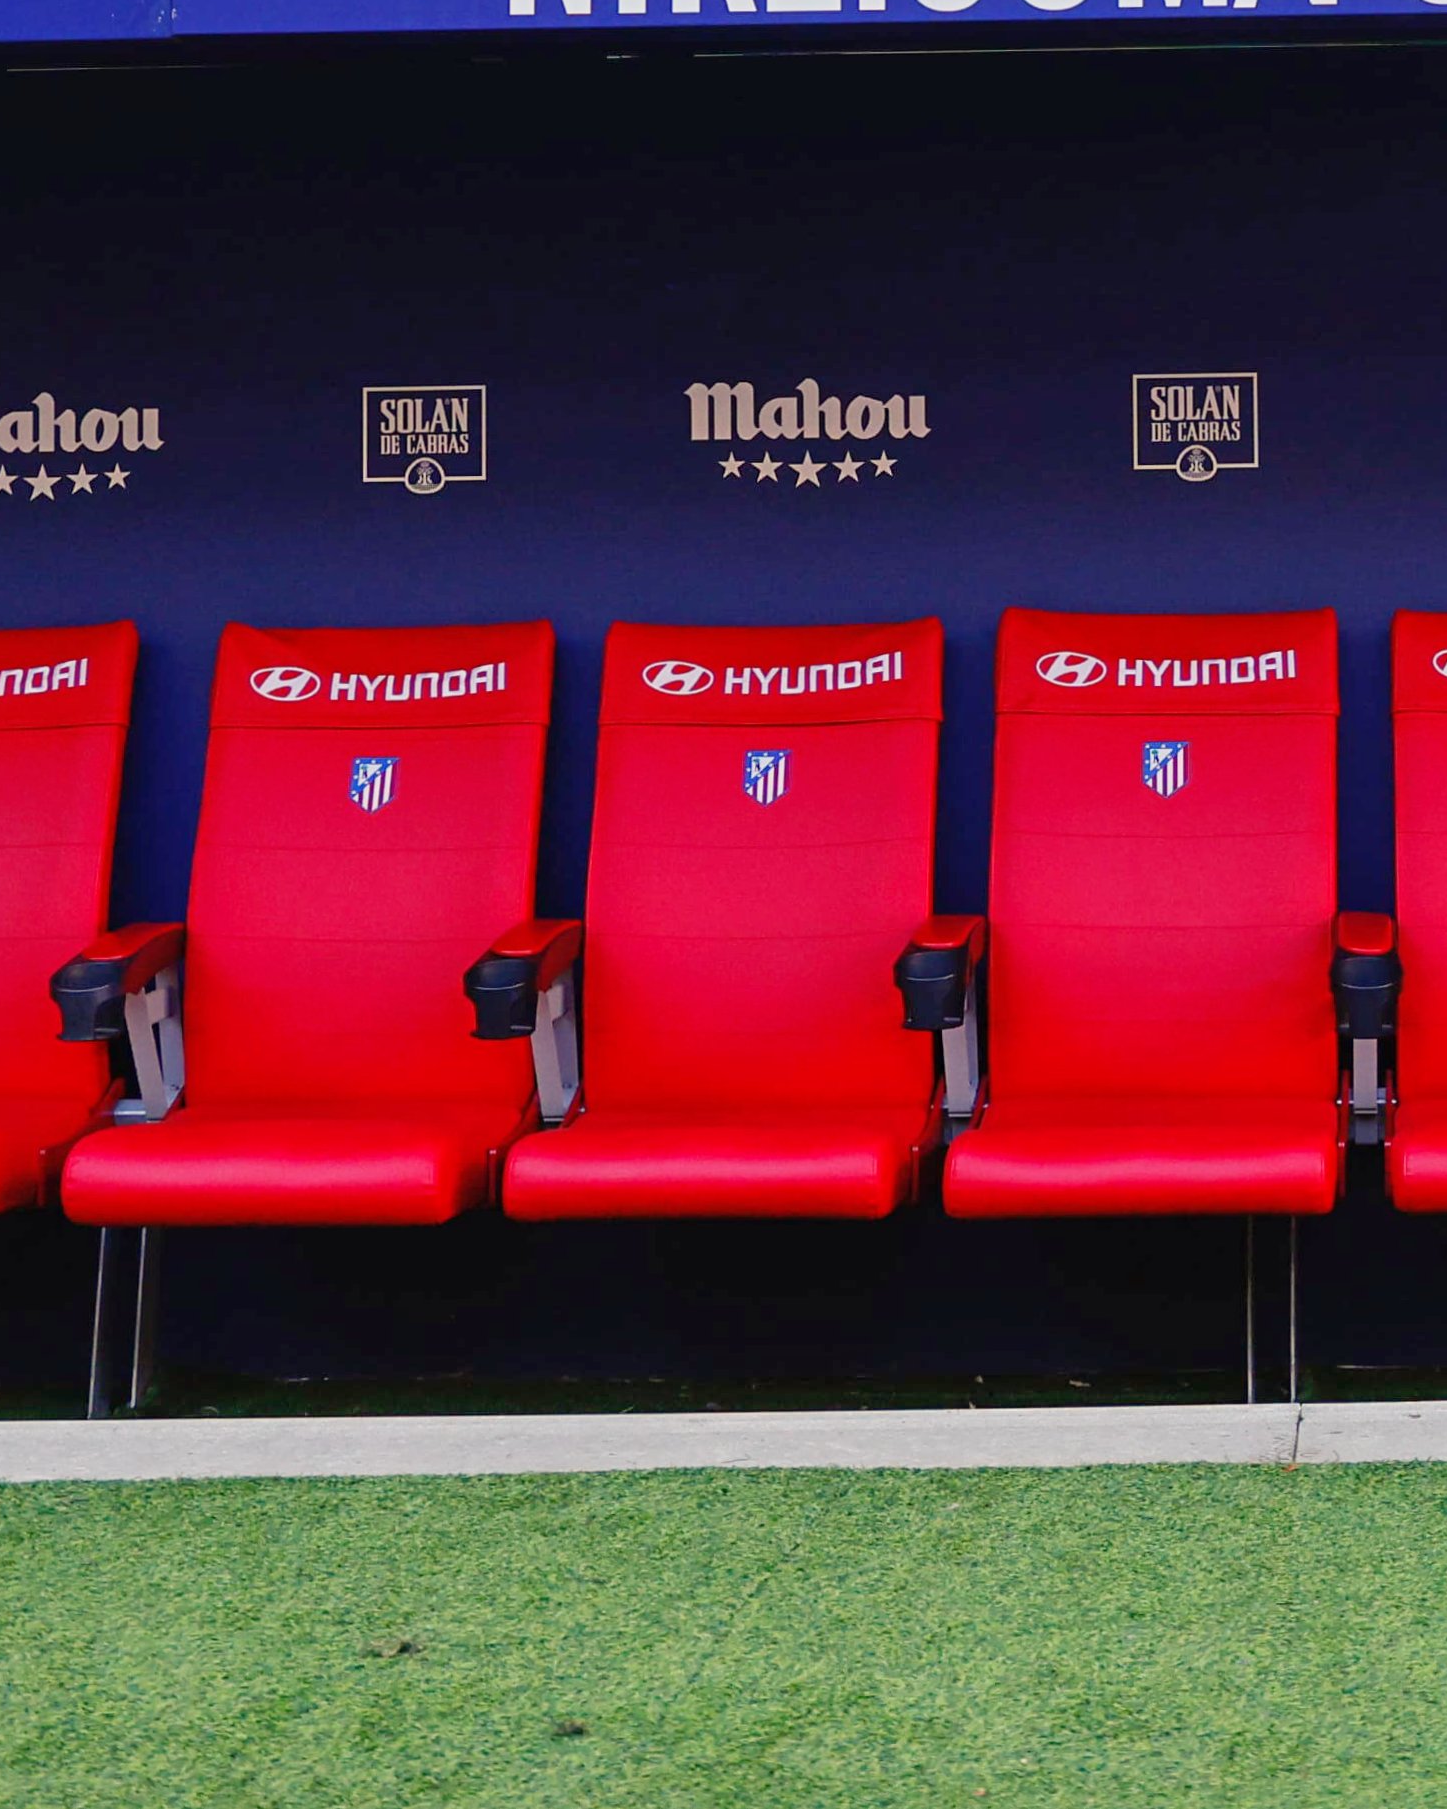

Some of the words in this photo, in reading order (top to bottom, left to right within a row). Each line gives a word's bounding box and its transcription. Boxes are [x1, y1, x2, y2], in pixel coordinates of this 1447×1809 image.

[381, 398, 468, 433] SOLAN
[684, 378, 931, 440] Mahou
[1151, 385, 1239, 421] SOLAN
[381, 435, 400, 454] DE
[407, 434, 468, 454] CABRAS
[1151, 423, 1171, 442] DE
[1178, 421, 1240, 441] CABRAS
[331, 663, 504, 700] HYUNDAI
[725, 652, 901, 694] HYUNDAI
[1118, 650, 1295, 686] HYUNDAI
